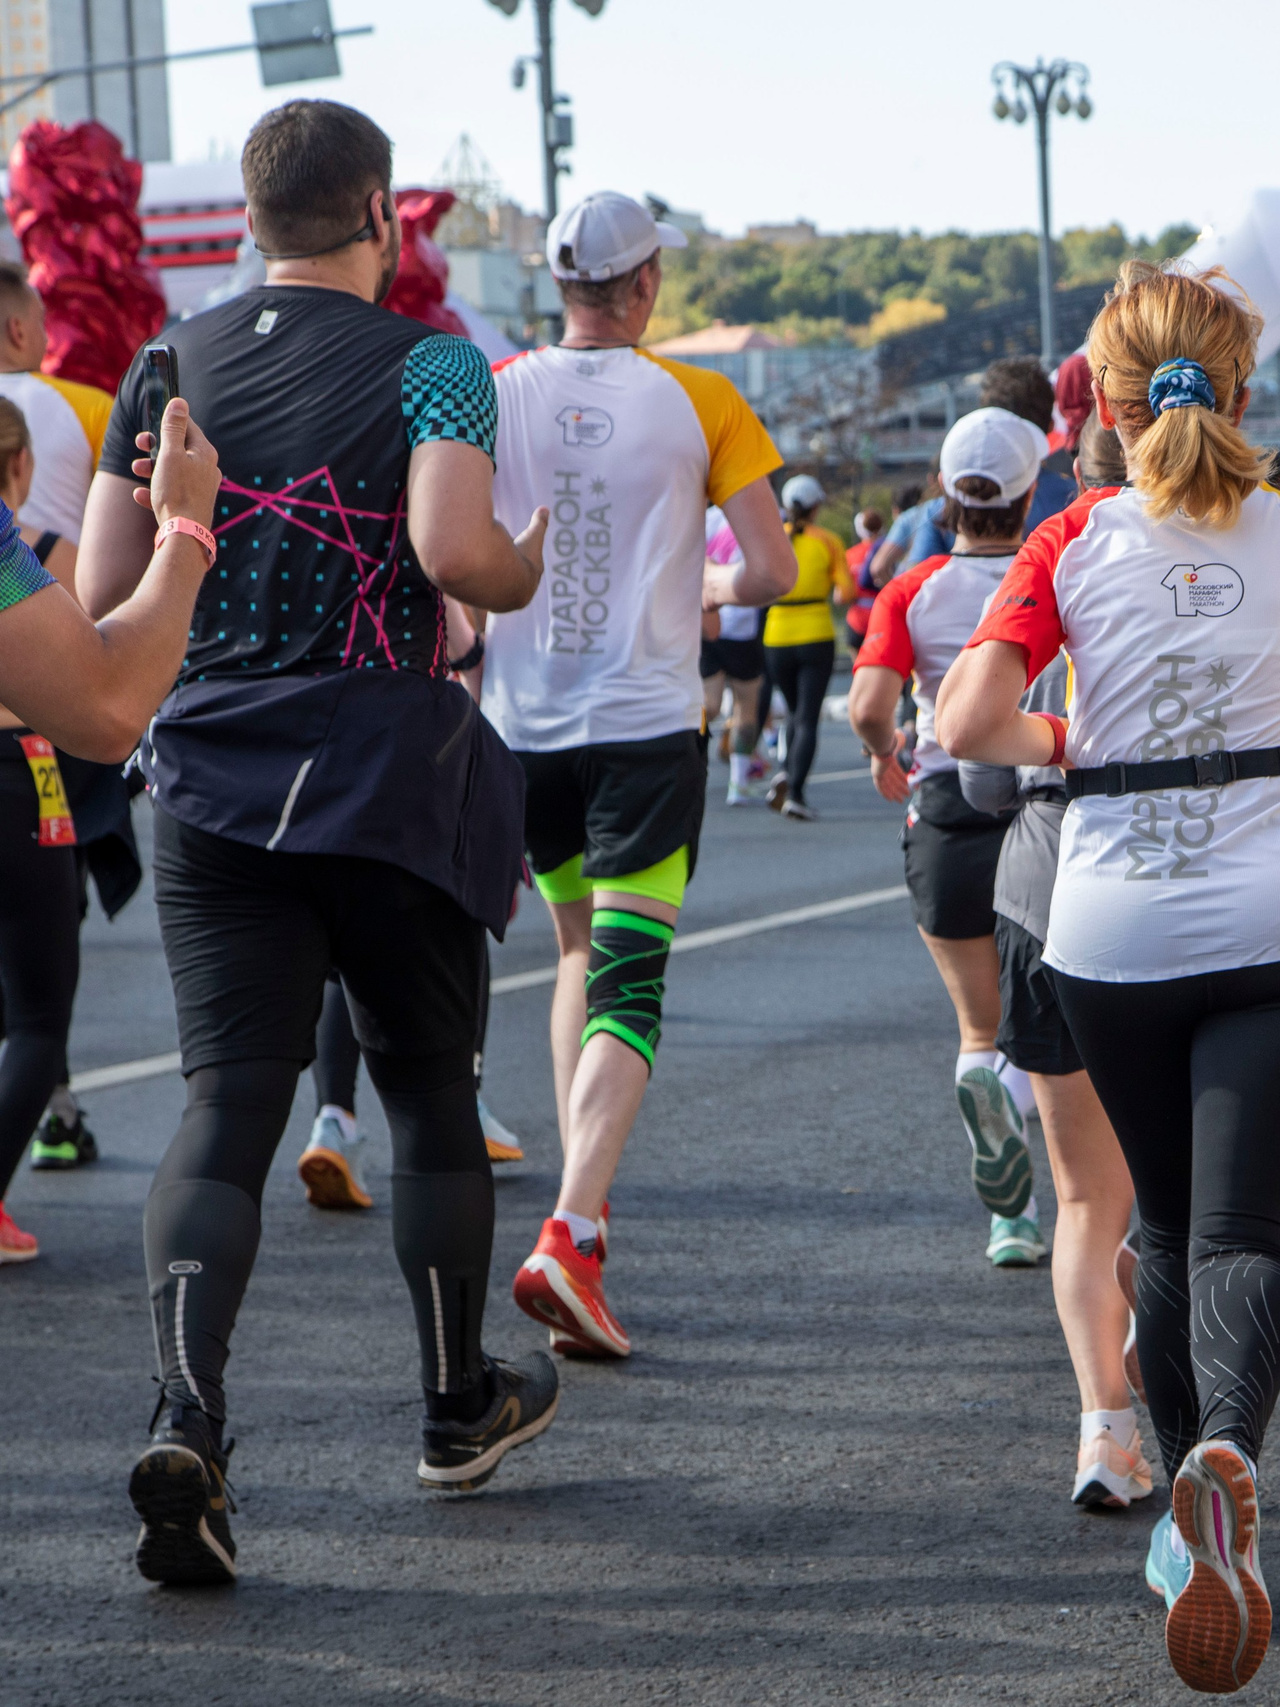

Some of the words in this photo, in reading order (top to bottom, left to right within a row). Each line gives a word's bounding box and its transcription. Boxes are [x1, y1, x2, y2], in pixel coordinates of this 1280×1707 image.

[550, 471, 581, 654] МАРАФОН
[578, 502, 612, 655] МОСКВА
[1188, 583, 1234, 591] МОСКОВСКИЙ
[1169, 697, 1233, 880] МОСВА
